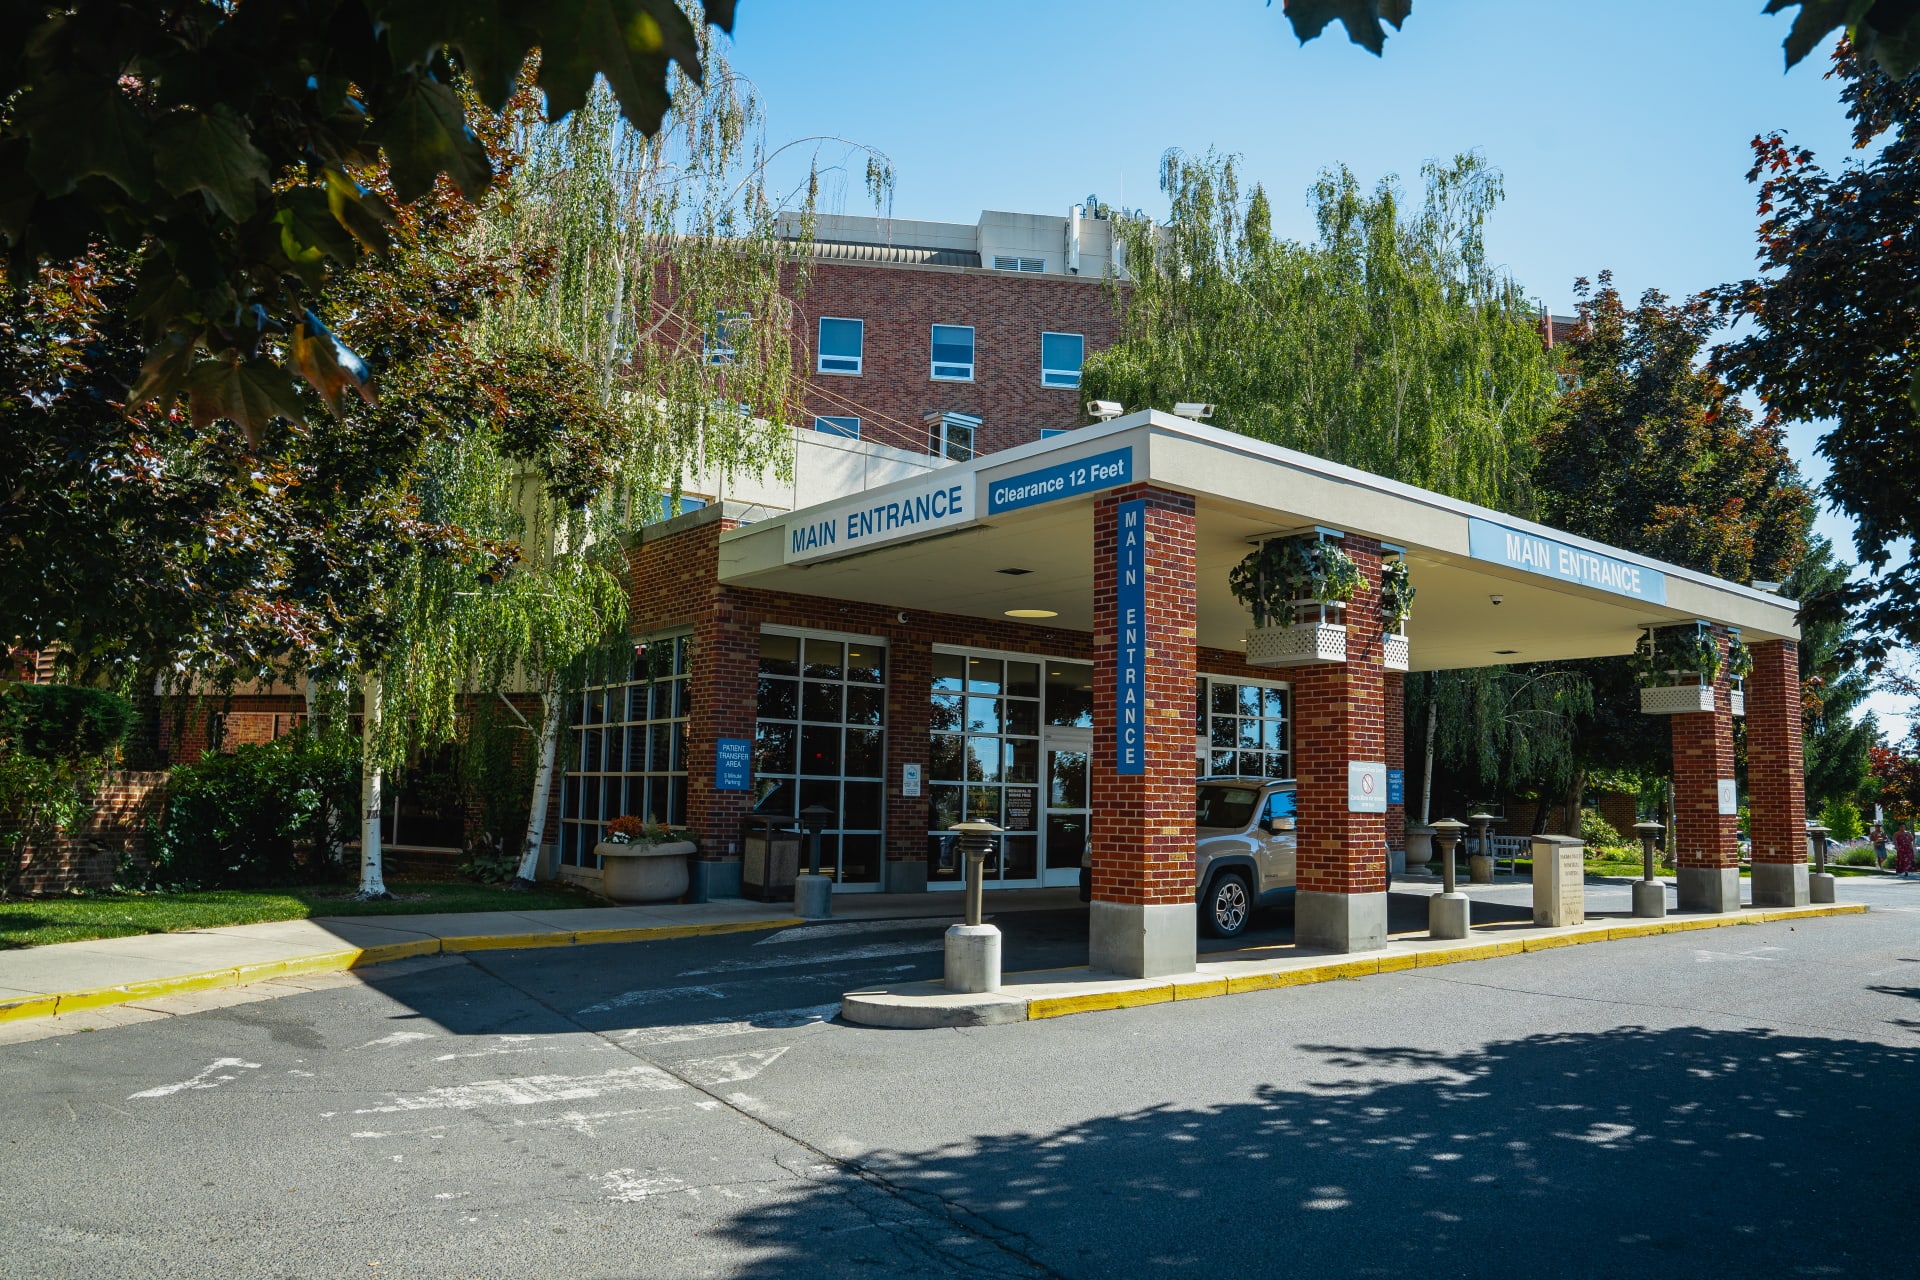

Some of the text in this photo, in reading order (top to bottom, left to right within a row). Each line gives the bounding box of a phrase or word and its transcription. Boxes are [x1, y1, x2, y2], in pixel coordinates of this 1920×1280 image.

[994, 459, 1125, 505] Clearance 12 Feet
[792, 485, 963, 553] MAIN ENTRANCE
[1506, 533, 1642, 593] MAIN ENTRANCE
[1125, 511, 1137, 764] MAIN ENTRANCE
[719, 752, 748, 760] TRANSFER
[722, 744, 746, 752] PATIENT
